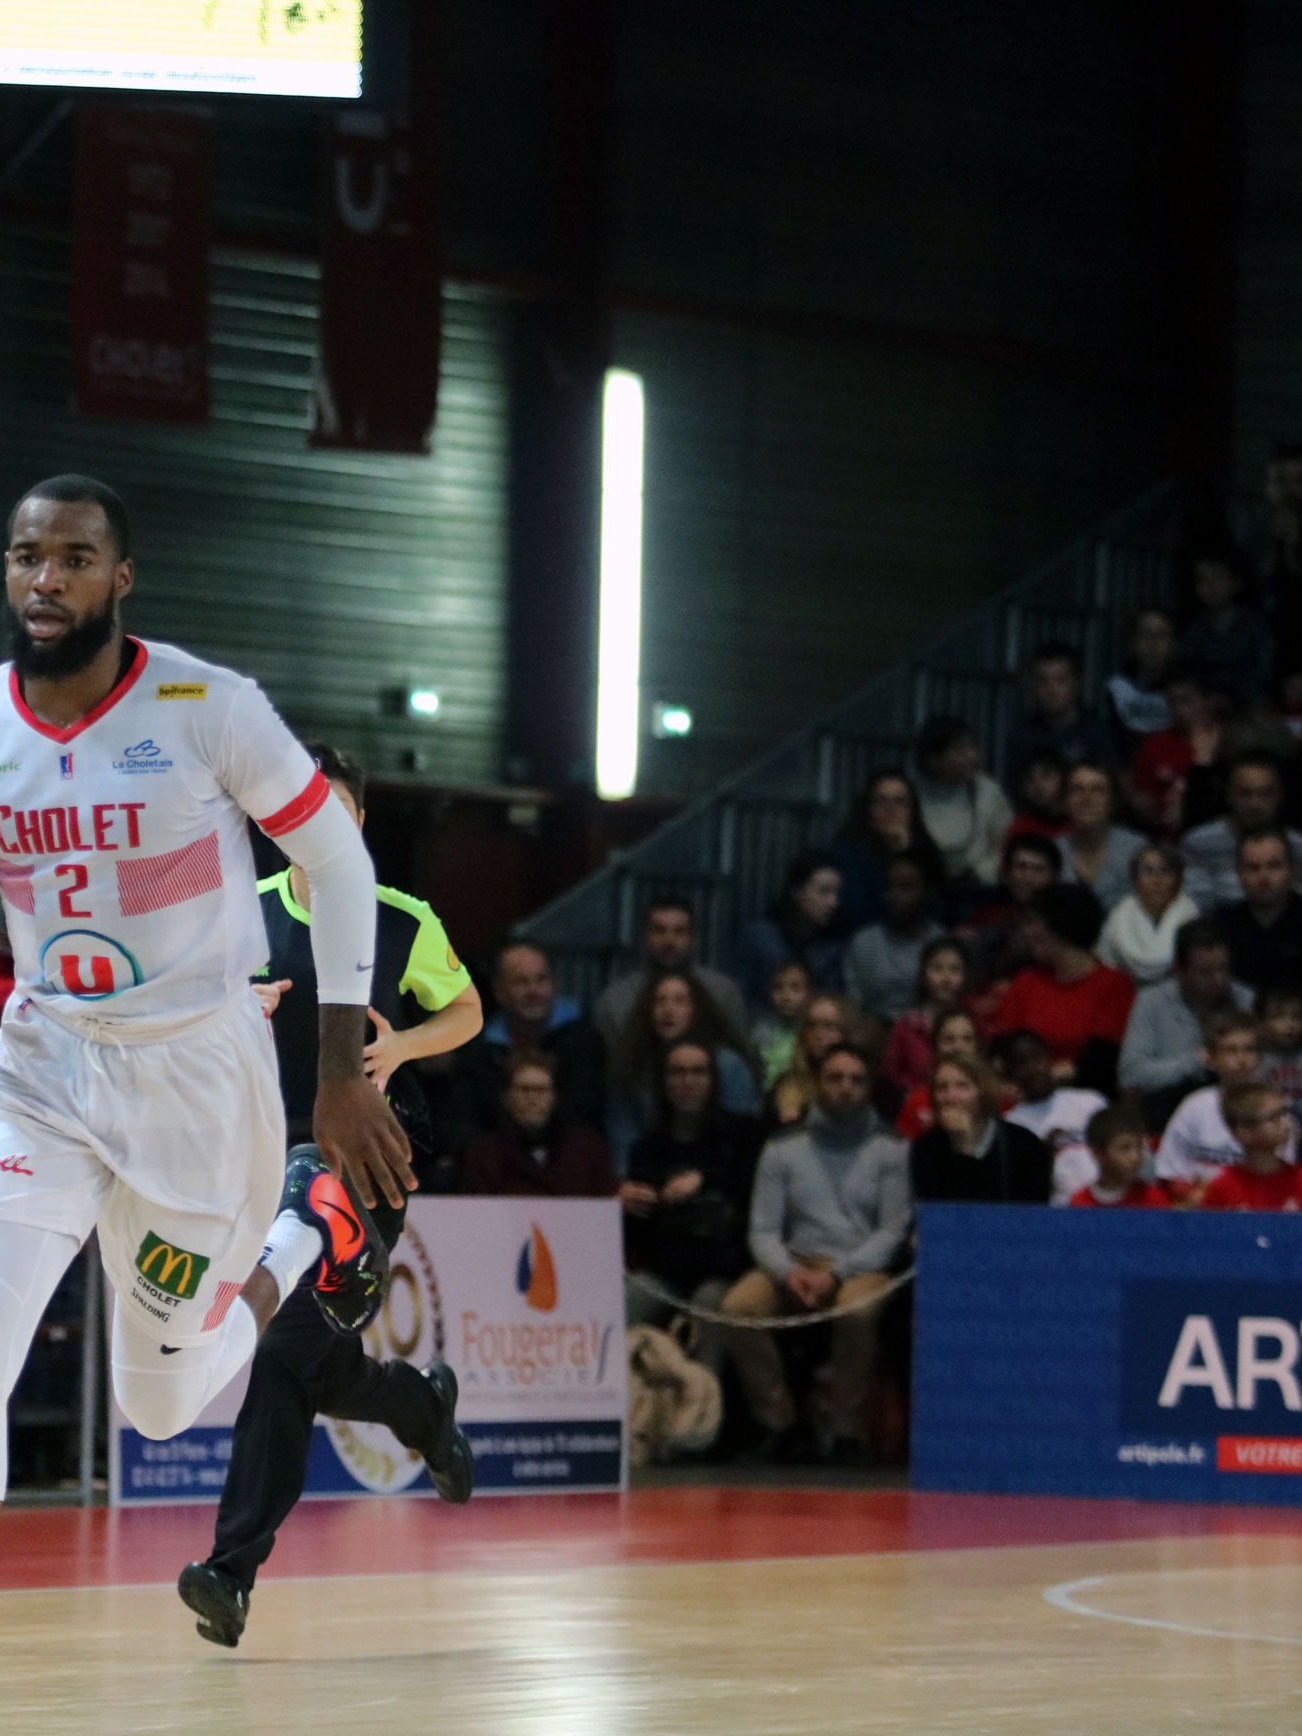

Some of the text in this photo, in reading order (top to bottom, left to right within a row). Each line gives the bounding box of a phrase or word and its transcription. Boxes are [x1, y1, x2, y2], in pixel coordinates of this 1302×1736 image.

[113, 758, 173, 769] Le Choletais
[55, 864, 92, 918] 2
[59, 955, 115, 994] U
[130, 1287, 170, 1323] SPALDING
[136, 1275, 182, 1308] CHOLET
[1157, 1314, 1302, 1412] AR
